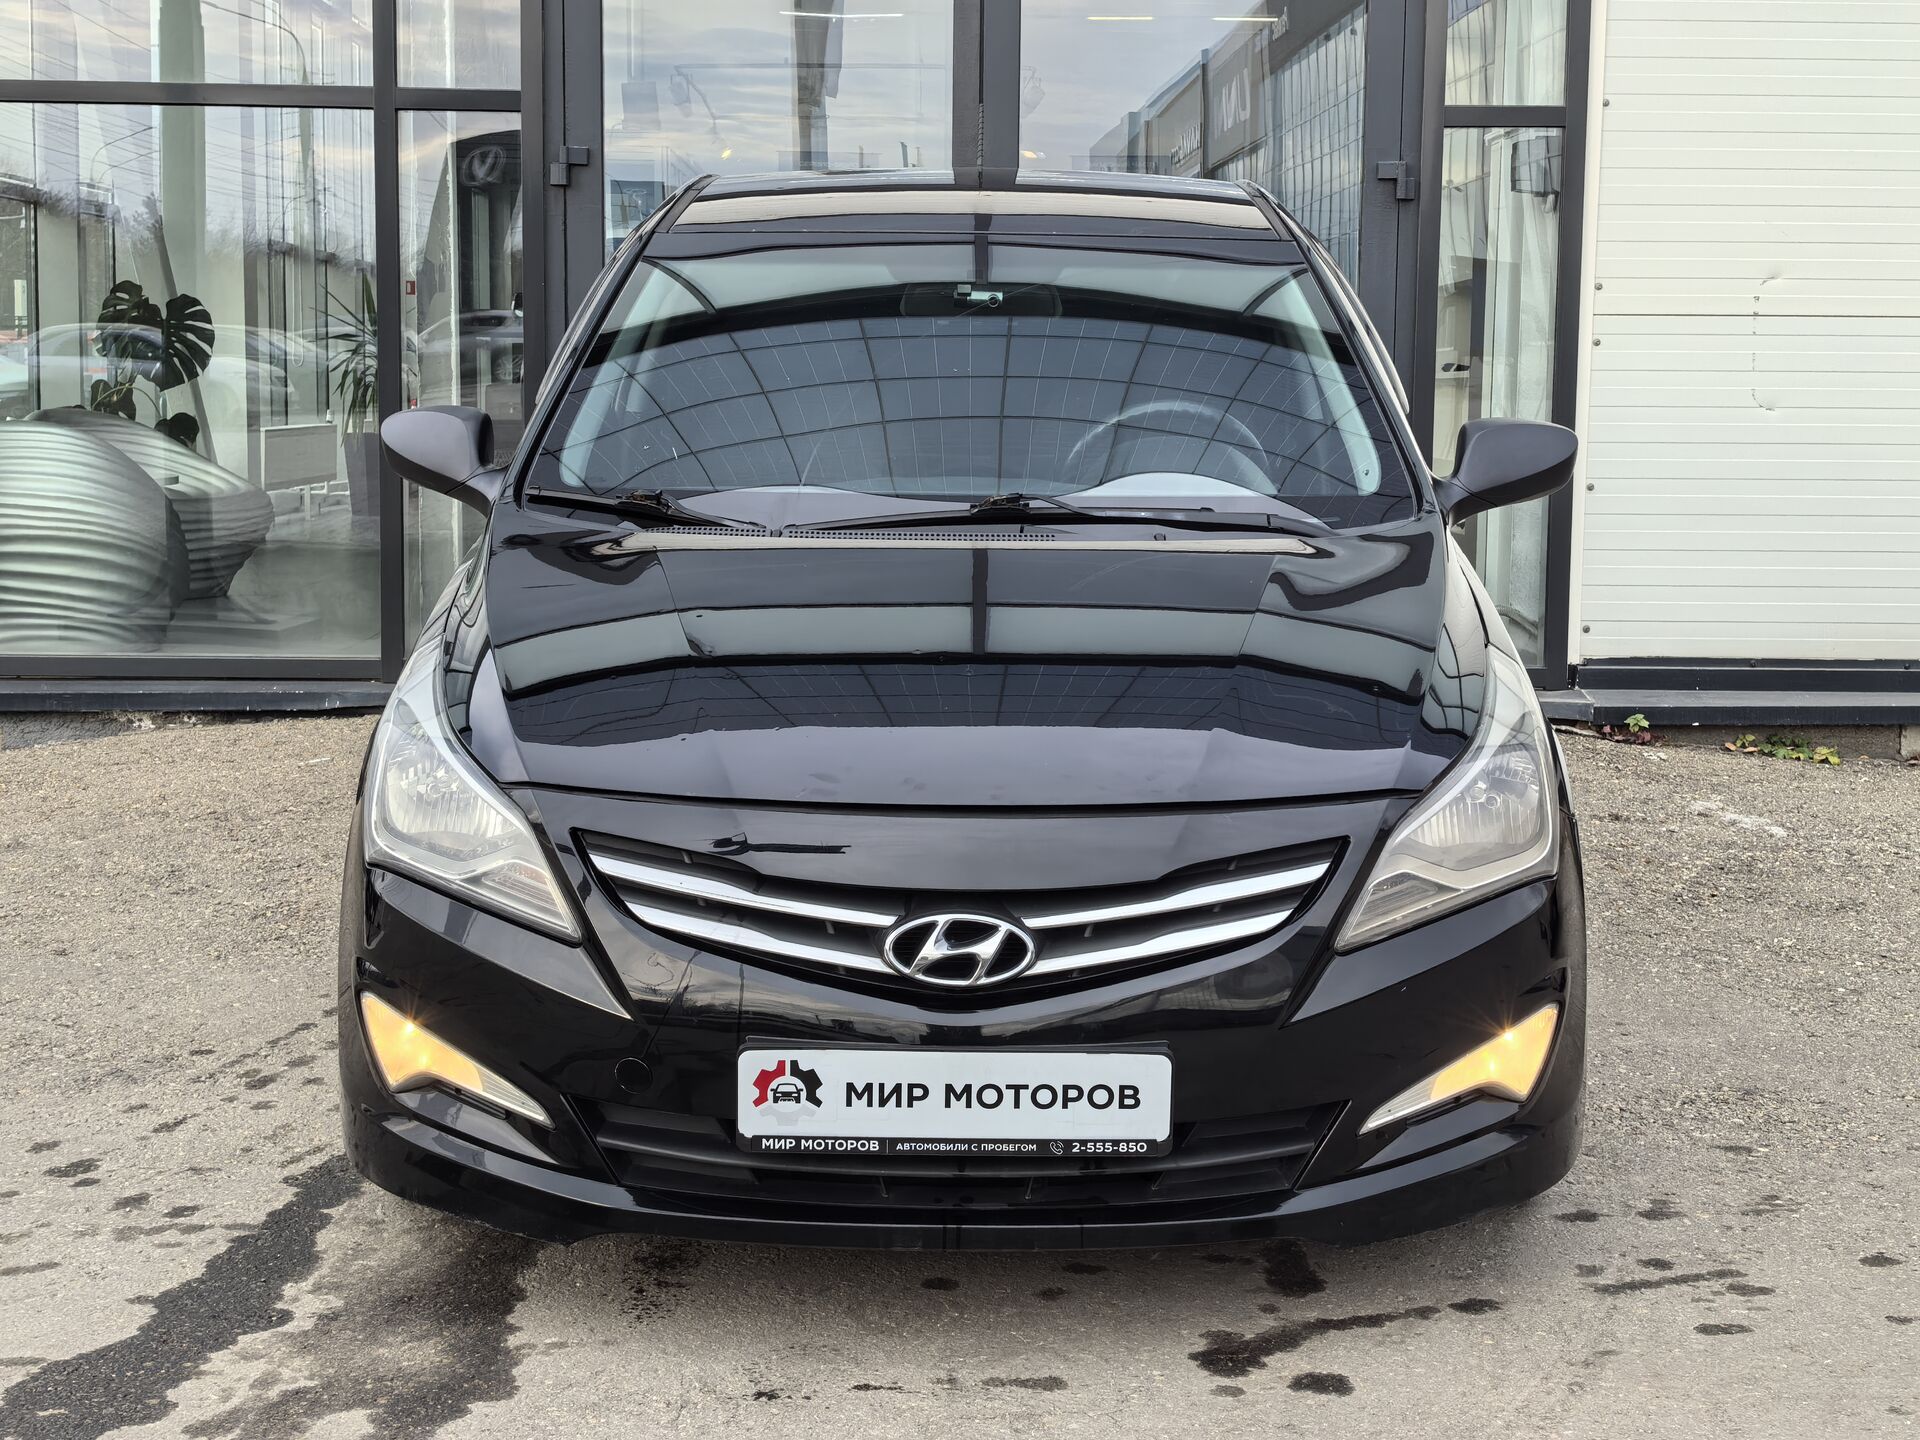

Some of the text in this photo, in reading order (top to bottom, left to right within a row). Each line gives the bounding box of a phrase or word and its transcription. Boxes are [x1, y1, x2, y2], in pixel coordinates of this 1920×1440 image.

[845, 1082, 1141, 1110] МИР МОТОРОВ
[761, 1138, 880, 1151] МИР МОТОРОВ
[895, 1142, 1037, 1152] АВТОМОБИЛИ С ПРОБЕГОМ
[1071, 1142, 1148, 1153] 2-555-850
